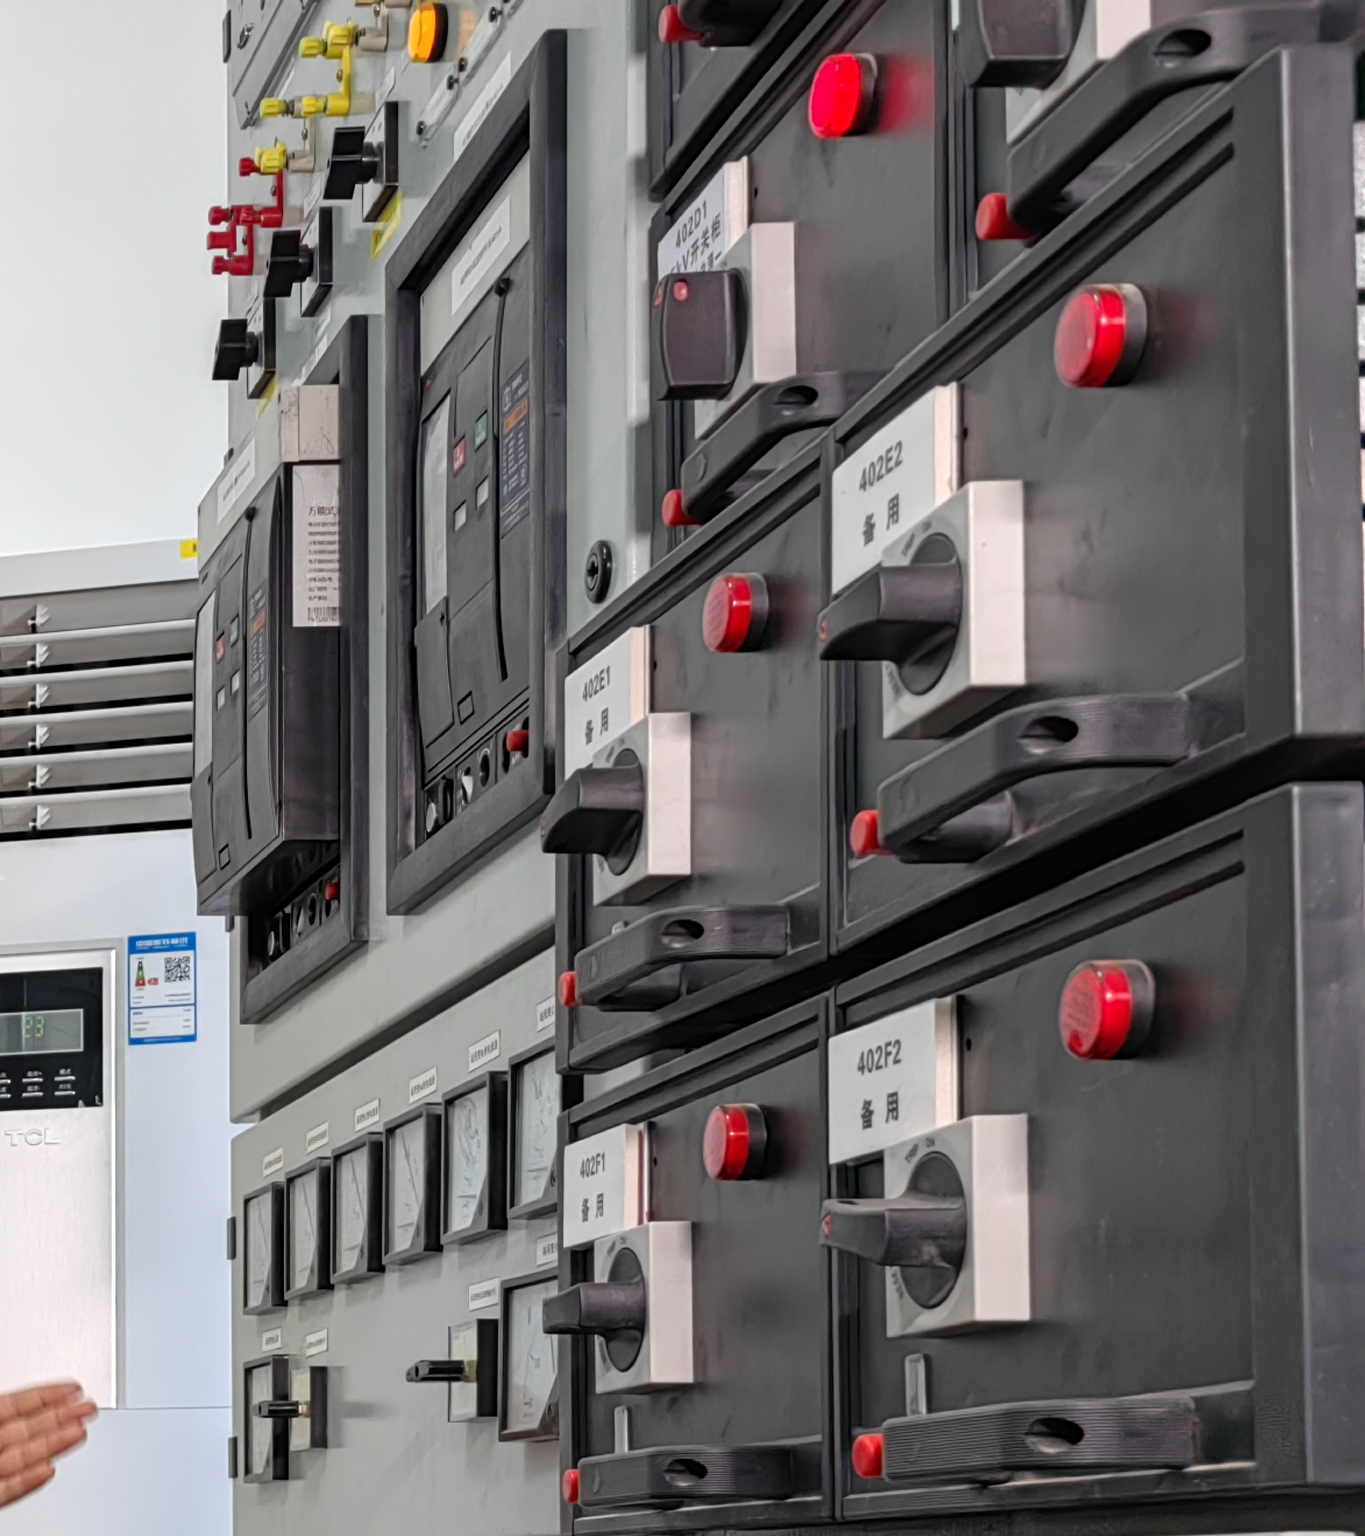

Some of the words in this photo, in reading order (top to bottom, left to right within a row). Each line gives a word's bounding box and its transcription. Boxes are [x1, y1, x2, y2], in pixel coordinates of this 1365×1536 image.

[675, 200, 707, 248] 402D1
[858, 440, 903, 492] 402E2
[861, 493, 900, 547] 备用
[582, 665, 611, 703] 402E1
[584, 707, 609, 746] 备用
[24, 1015, 45, 1039] 23
[857, 1039, 902, 1075] 402F2
[860, 1091, 899, 1130] 备用
[4, 1128, 62, 1147] TCL
[580, 1152, 605, 1179] 402F1
[581, 1193, 604, 1223] 备用
